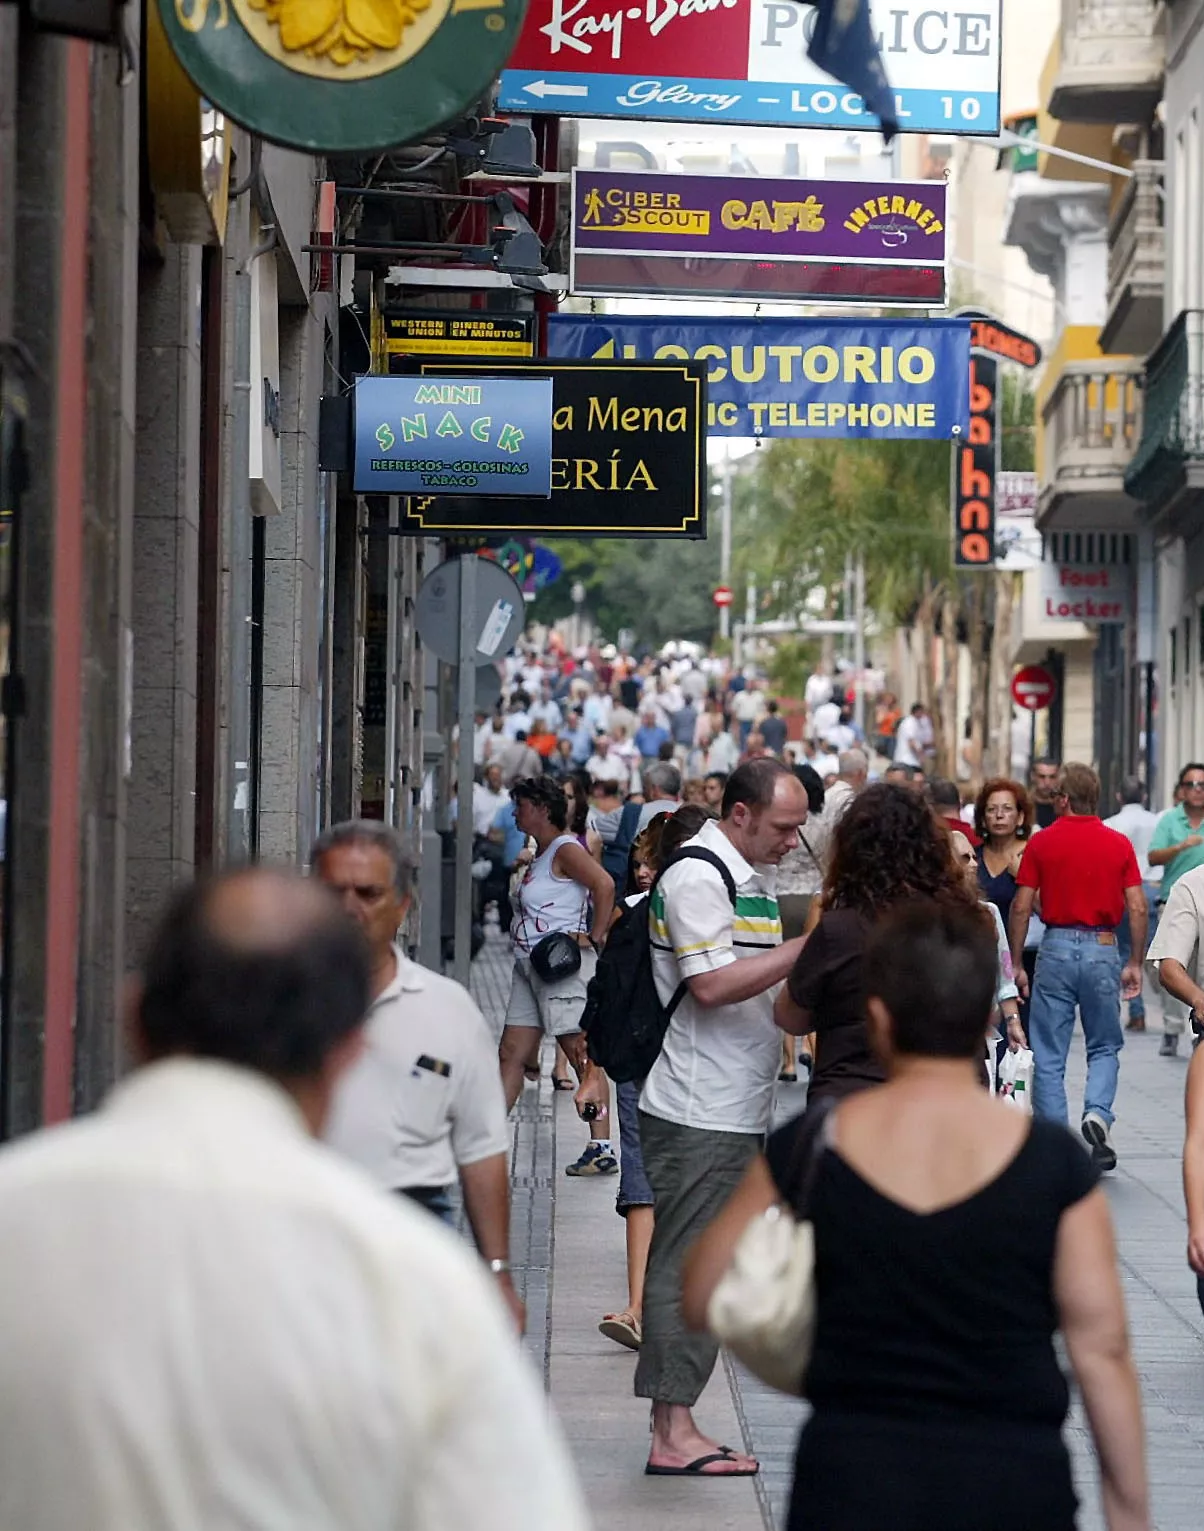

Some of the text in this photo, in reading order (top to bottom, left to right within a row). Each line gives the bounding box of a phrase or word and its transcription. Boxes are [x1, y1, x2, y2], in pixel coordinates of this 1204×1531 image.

[761, 3, 991, 56] PICE
[616, 81, 742, 111] Glory
[791, 90, 911, 117] LOCL
[940, 97, 981, 120] 10
[606, 189, 681, 208] CIBER
[627, 209, 706, 228] SCOUT
[721, 195, 825, 233] CAFÉ
[843, 195, 944, 236] INTERNET
[391, 319, 444, 328] WESTERN
[407, 328, 444, 336] UNION
[452, 321, 494, 330] DINERO
[452, 329, 522, 339] EN MINUTOS
[414, 384, 481, 405] MINI
[587, 396, 687, 433] Mena
[748, 402, 936, 427] TELEPHONE
[375, 411, 525, 454] SNACK
[421, 474, 478, 487] TABACO
[1059, 566, 1109, 588] Foot
[1046, 597, 1123, 618] Locker
